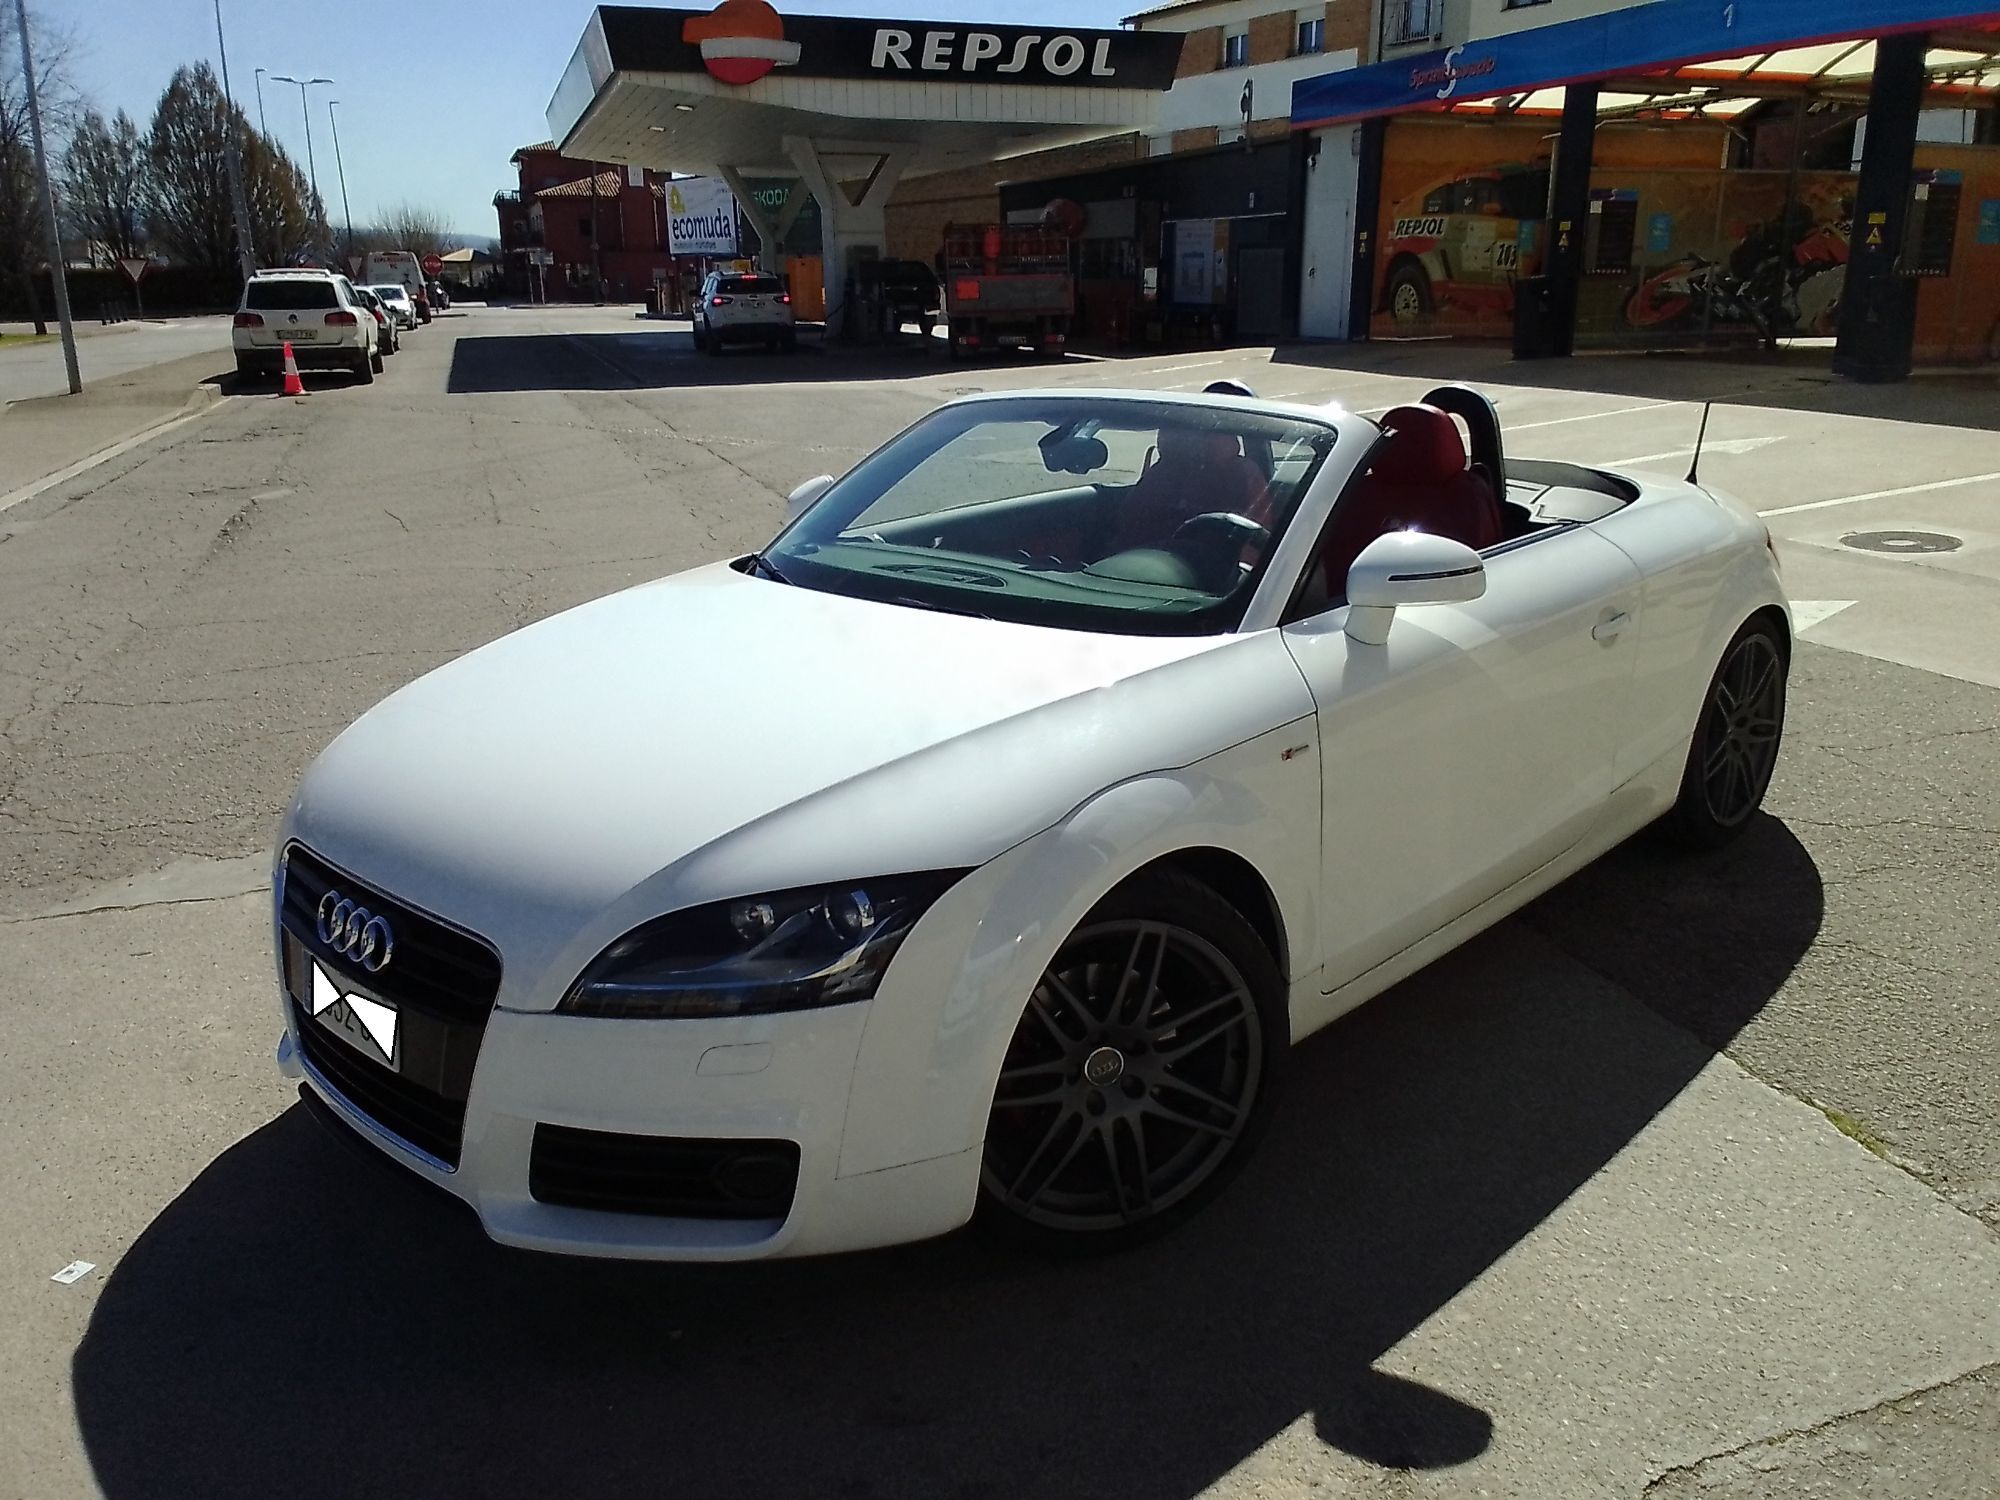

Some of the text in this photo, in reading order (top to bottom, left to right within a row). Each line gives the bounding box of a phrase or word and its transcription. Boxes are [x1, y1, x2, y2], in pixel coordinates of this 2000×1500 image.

[871, 29, 1116, 76] REPSOL
[672, 207, 731, 240] ecomuda
[1395, 218, 1444, 236] REPSOL
